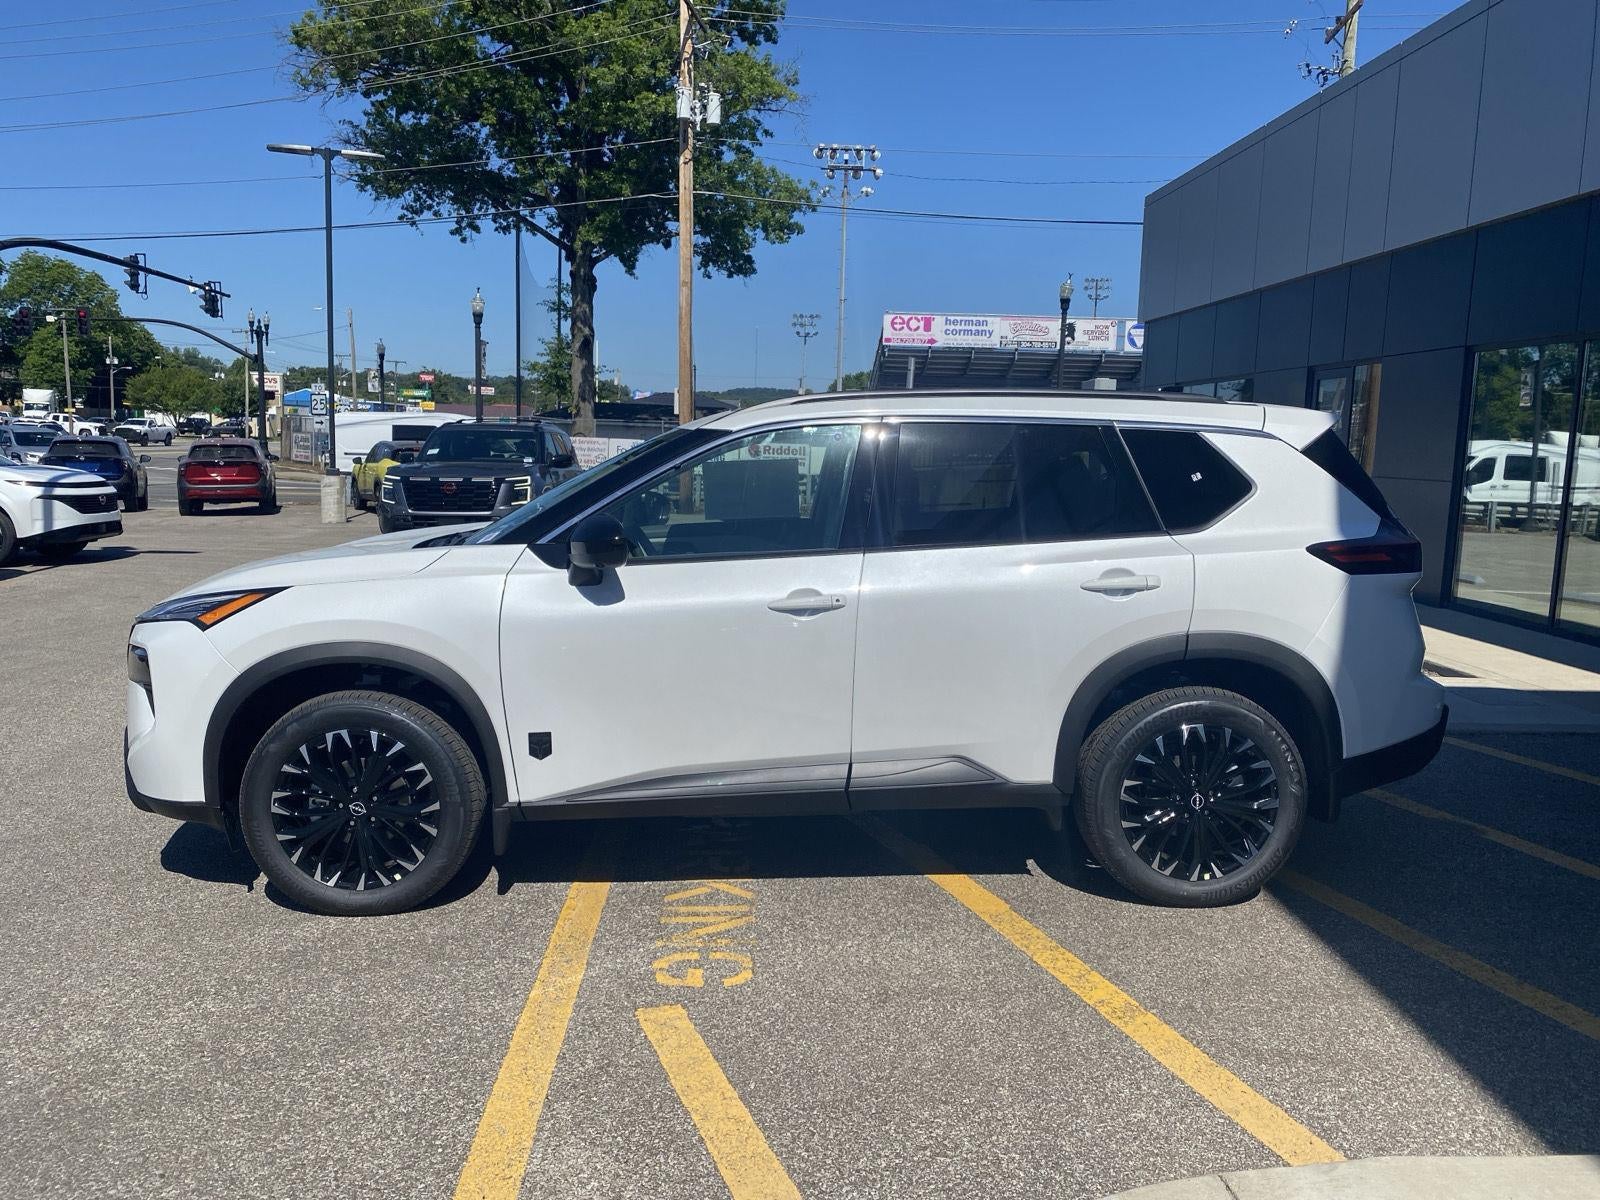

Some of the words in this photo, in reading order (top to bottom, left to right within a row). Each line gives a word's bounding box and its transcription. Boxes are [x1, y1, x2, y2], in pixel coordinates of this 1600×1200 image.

[944, 316, 988, 327] herman
[944, 327, 993, 339] cormany
[312, 398, 325, 411] 25
[762, 445, 806, 457] Riddell
